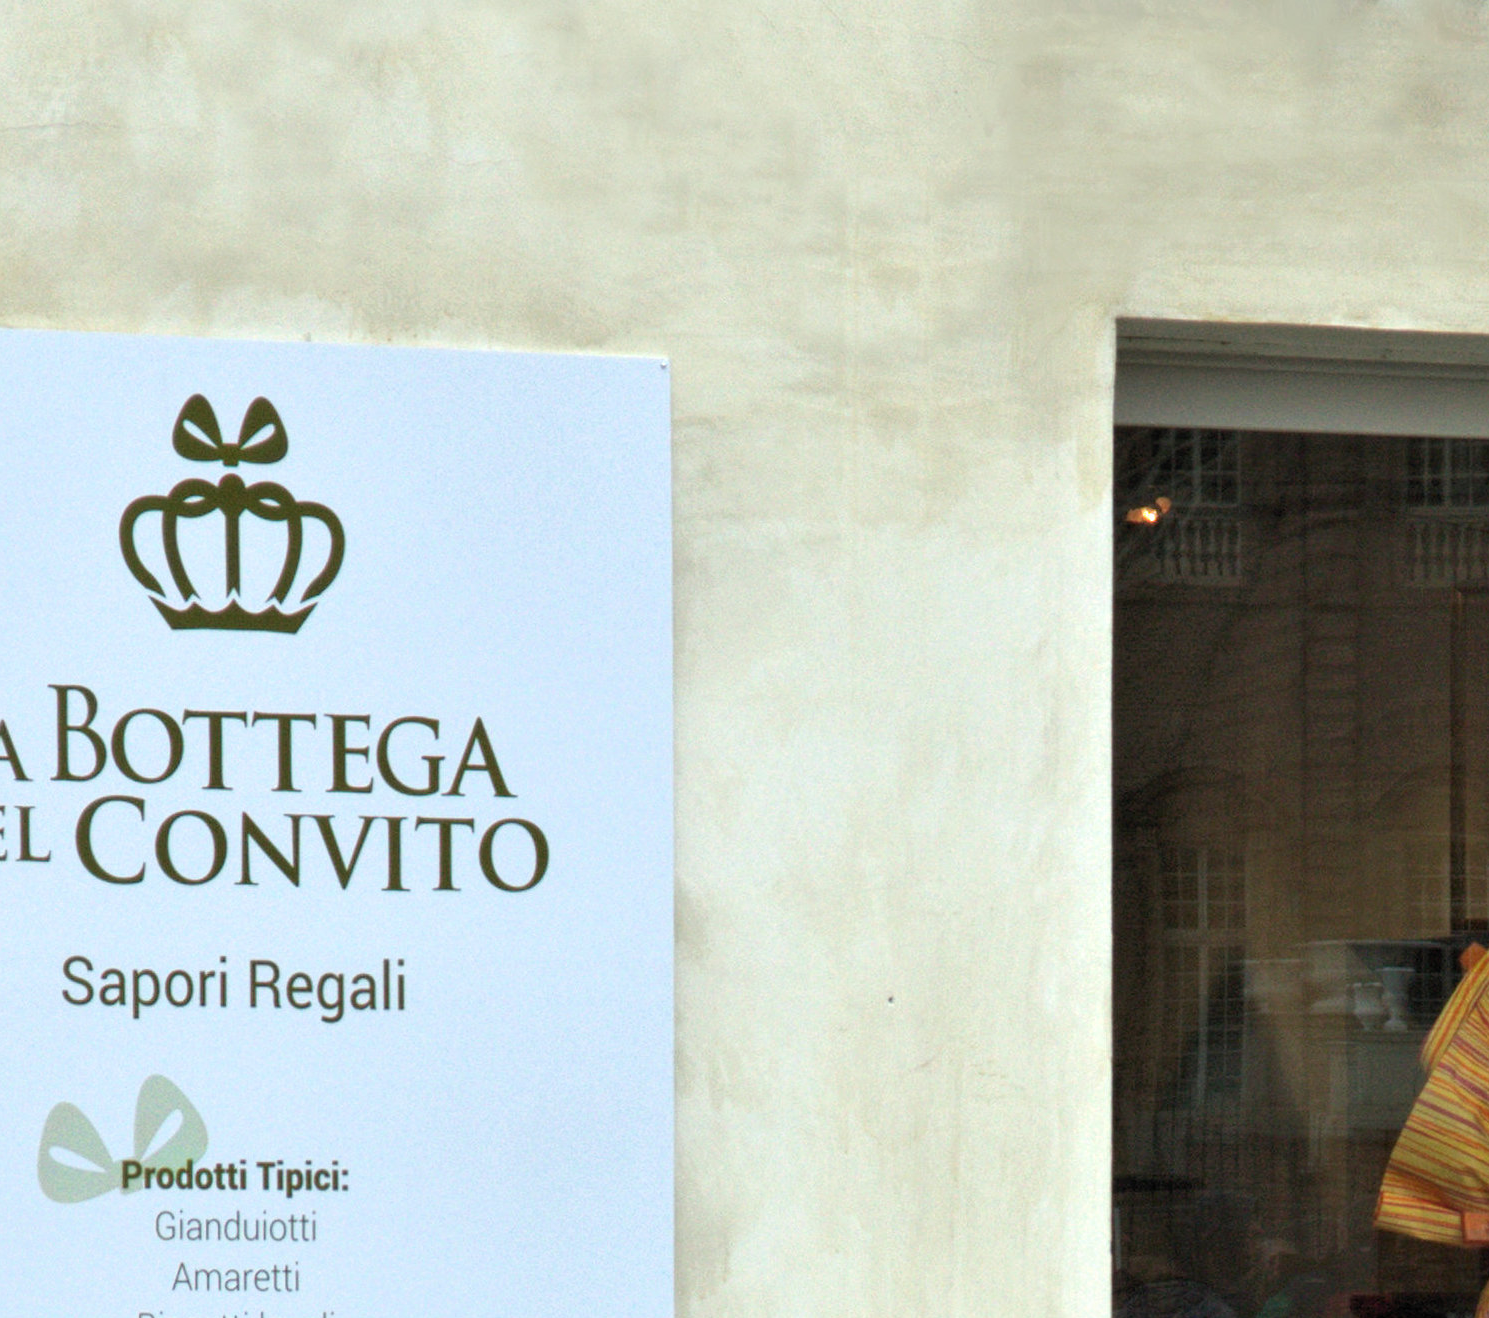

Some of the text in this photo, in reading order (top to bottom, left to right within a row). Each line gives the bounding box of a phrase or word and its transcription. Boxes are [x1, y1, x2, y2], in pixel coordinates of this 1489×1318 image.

[47, 683, 519, 800] BOTTEGA
[74, 794, 551, 894] CONVITO
[61, 955, 406, 1025] Sapori Regali
[120, 1158, 350, 1200] Prodotti Tipici:
[155, 1209, 317, 1243] Gianduiotti
[171, 1261, 300, 1293] Amaretti
